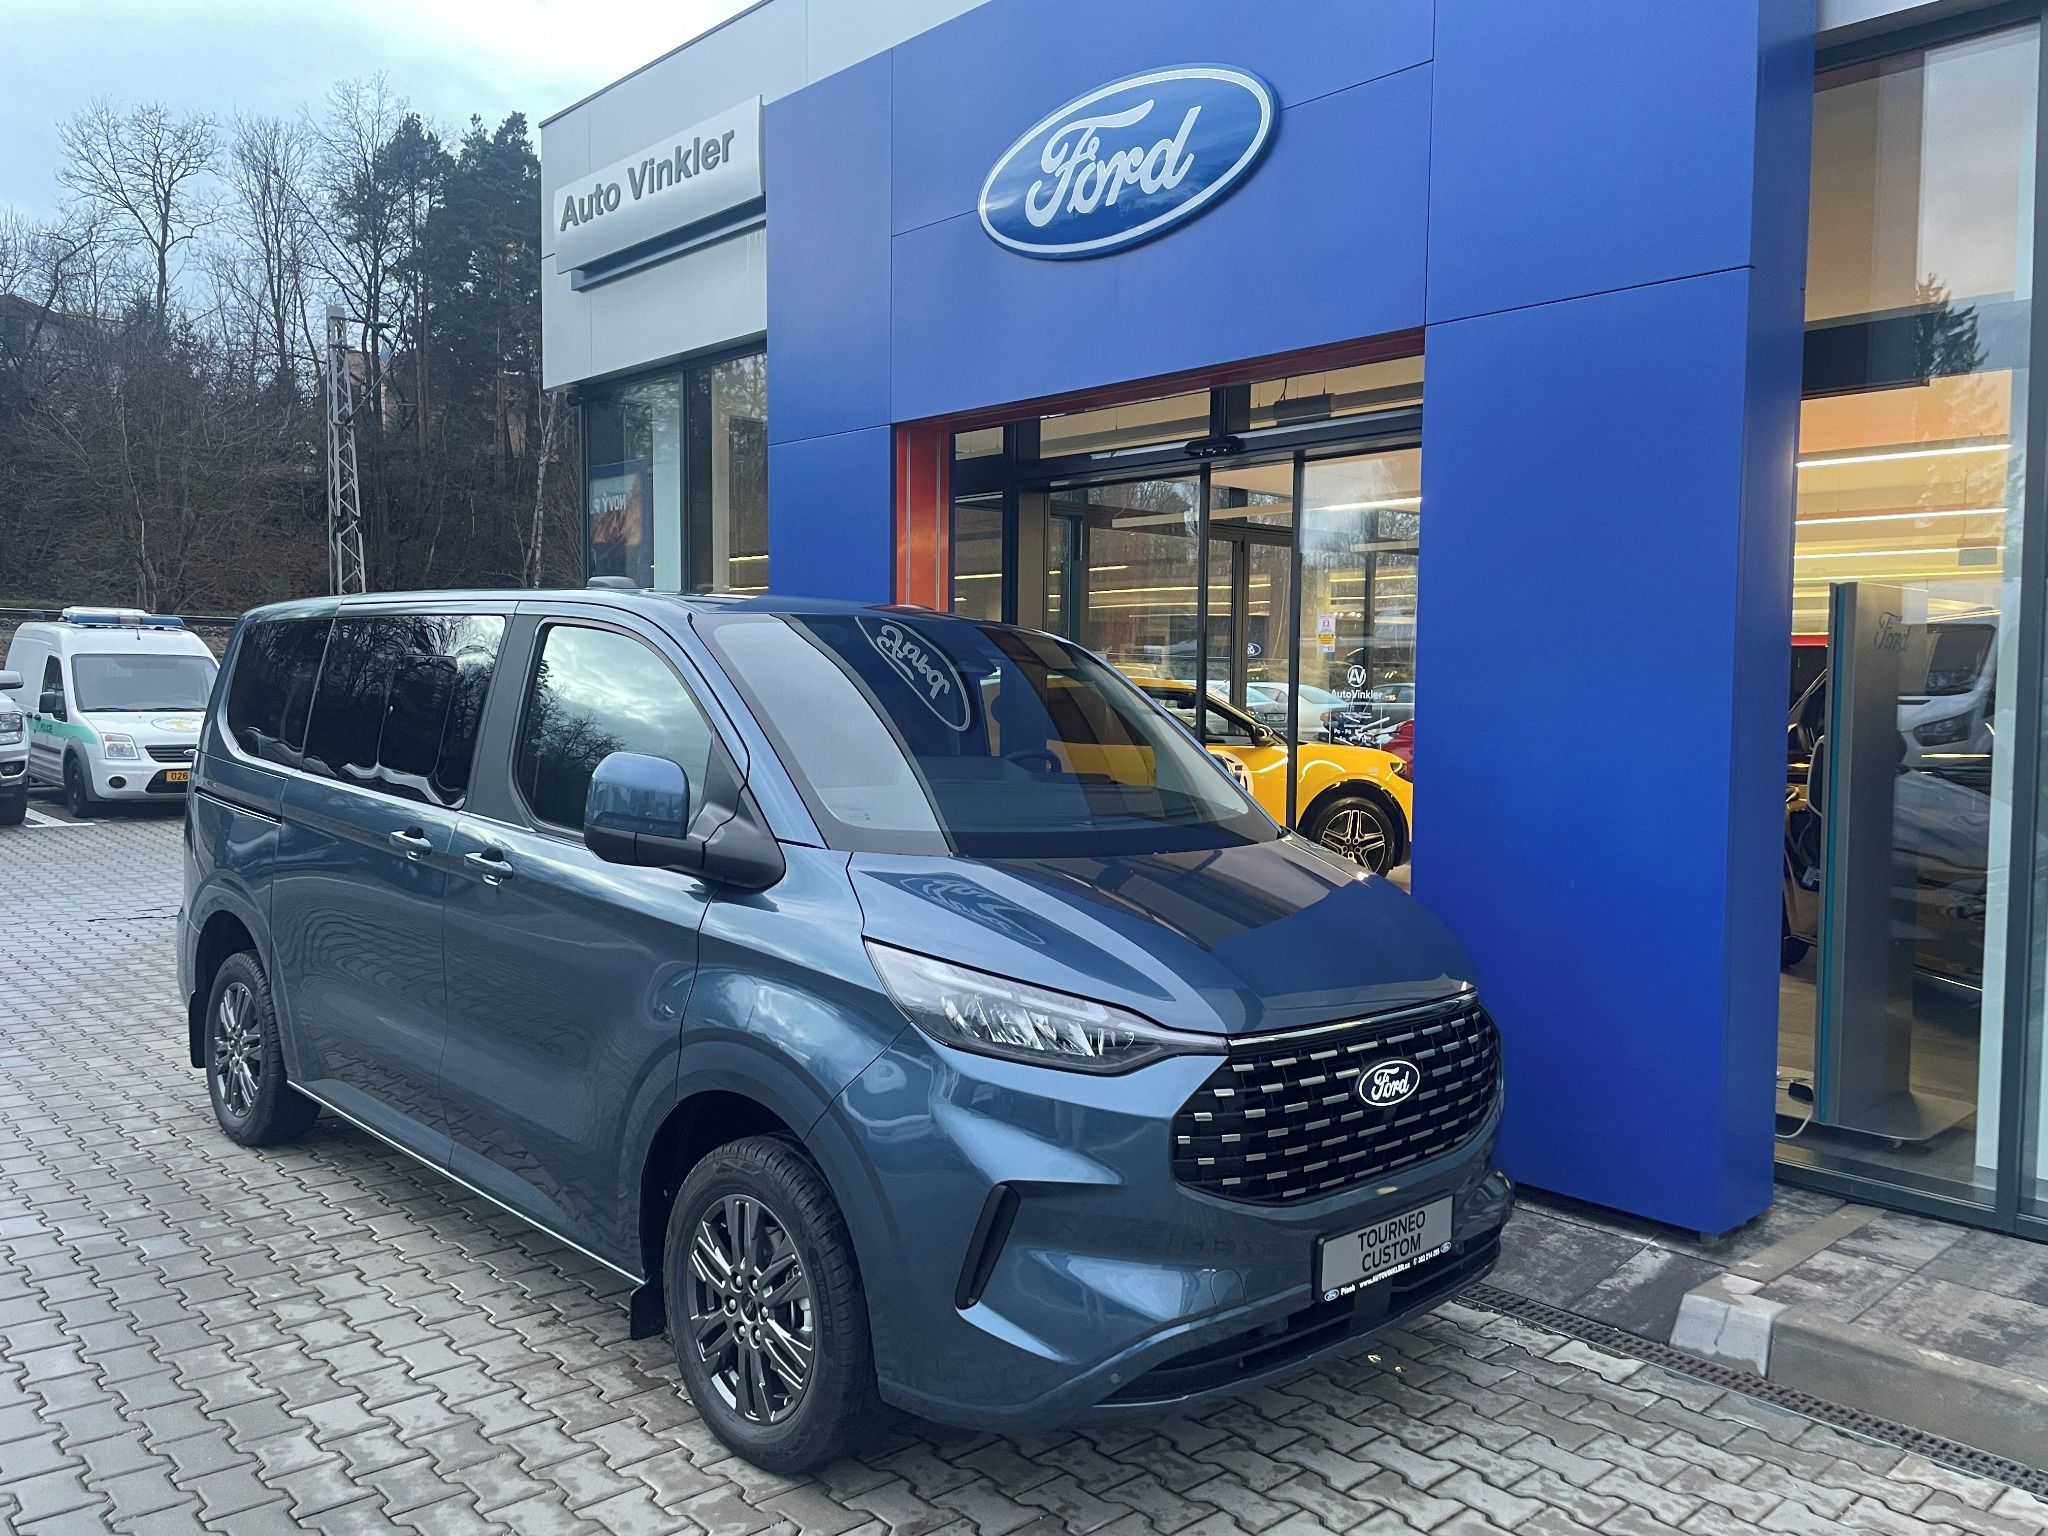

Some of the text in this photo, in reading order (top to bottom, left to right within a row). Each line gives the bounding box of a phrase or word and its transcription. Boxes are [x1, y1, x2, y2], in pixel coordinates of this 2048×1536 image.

[560, 129, 735, 232] Auto Vinkler
[1025, 99, 1201, 227] Ford
[1874, 611, 1911, 651] Ford
[1331, 689, 1383, 700] AutoVinkler
[171, 772, 188, 781] 026
[1371, 1067, 1410, 1101] Ford
[1358, 1210, 1426, 1251] TOURNEO
[1362, 1233, 1421, 1272] CUSTOM
